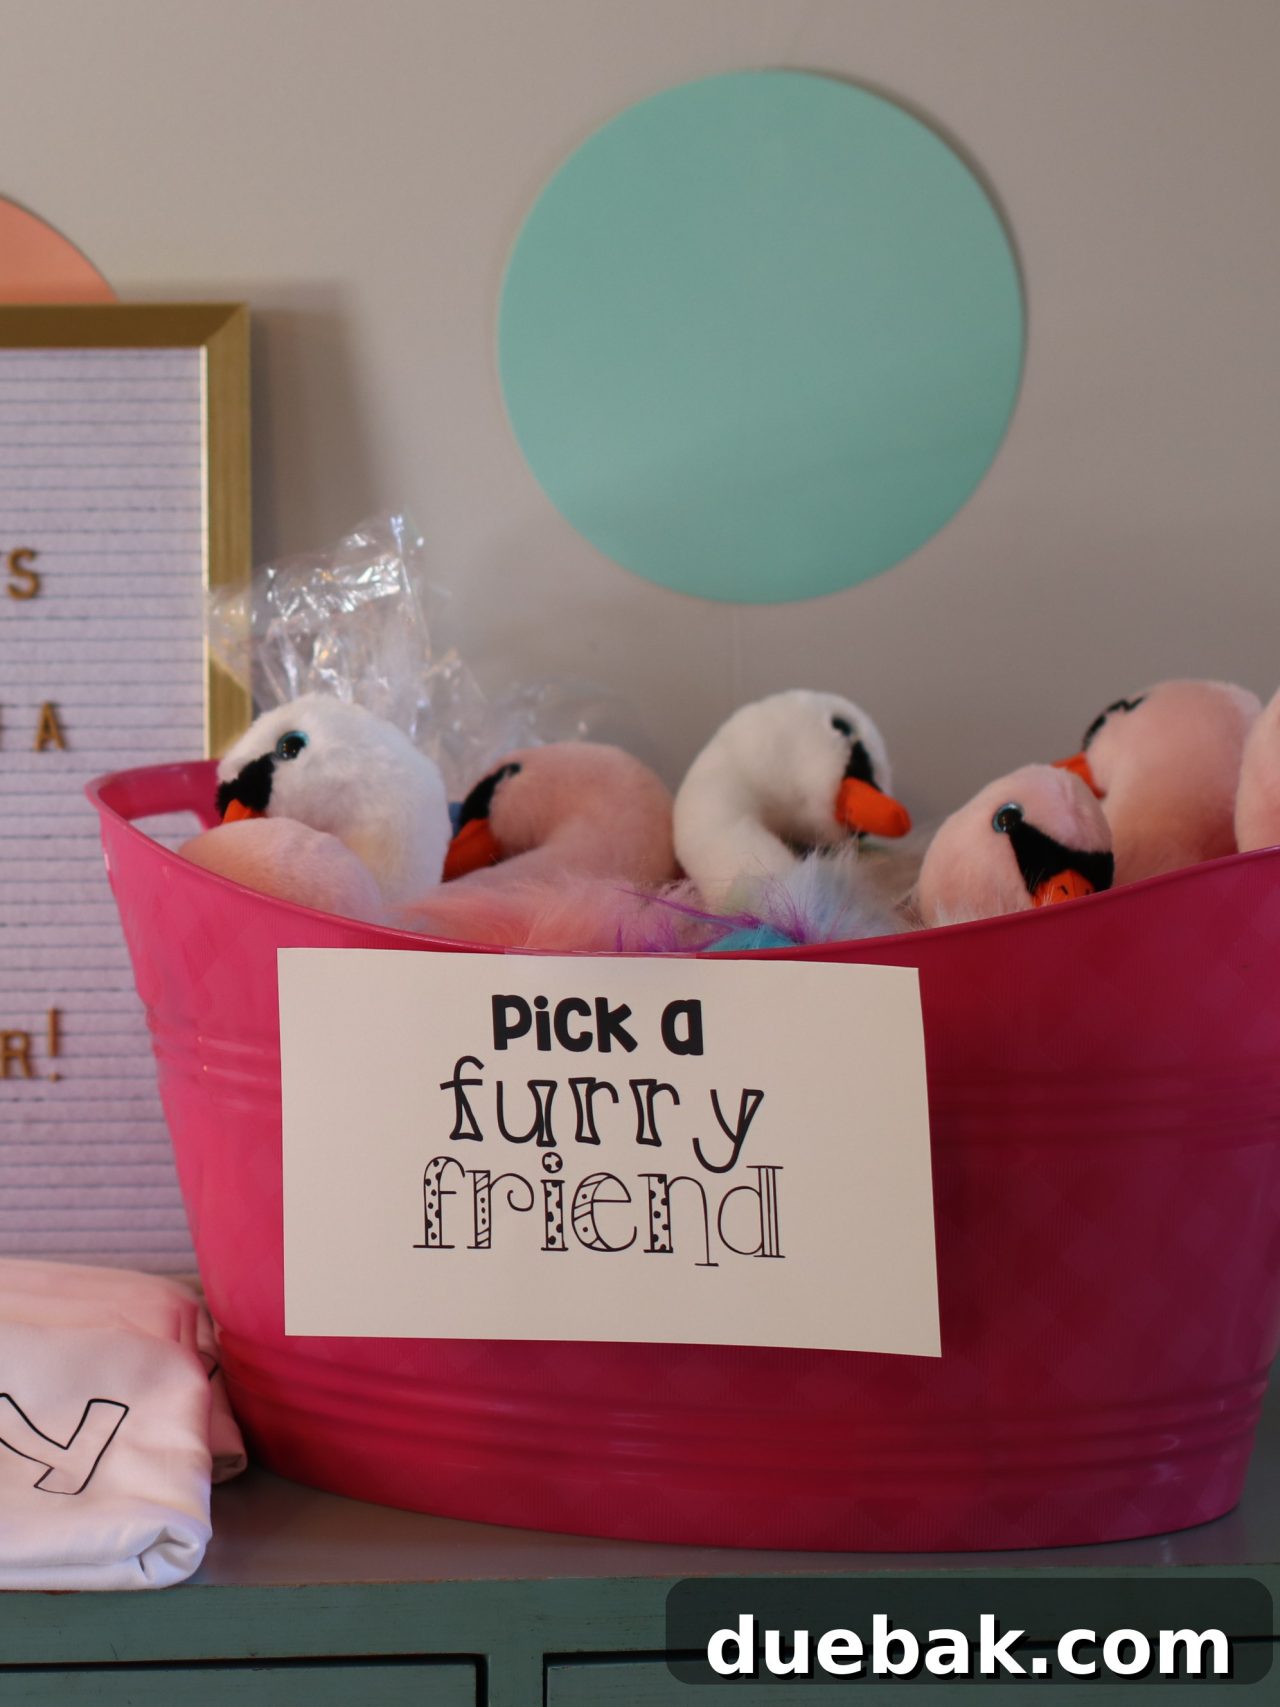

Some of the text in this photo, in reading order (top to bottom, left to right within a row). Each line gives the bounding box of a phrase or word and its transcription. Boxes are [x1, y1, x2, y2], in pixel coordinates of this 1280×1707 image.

[661, 998, 705, 1056] a
[440, 1055, 765, 1174] furry
[412, 1151, 787, 1268] friend
